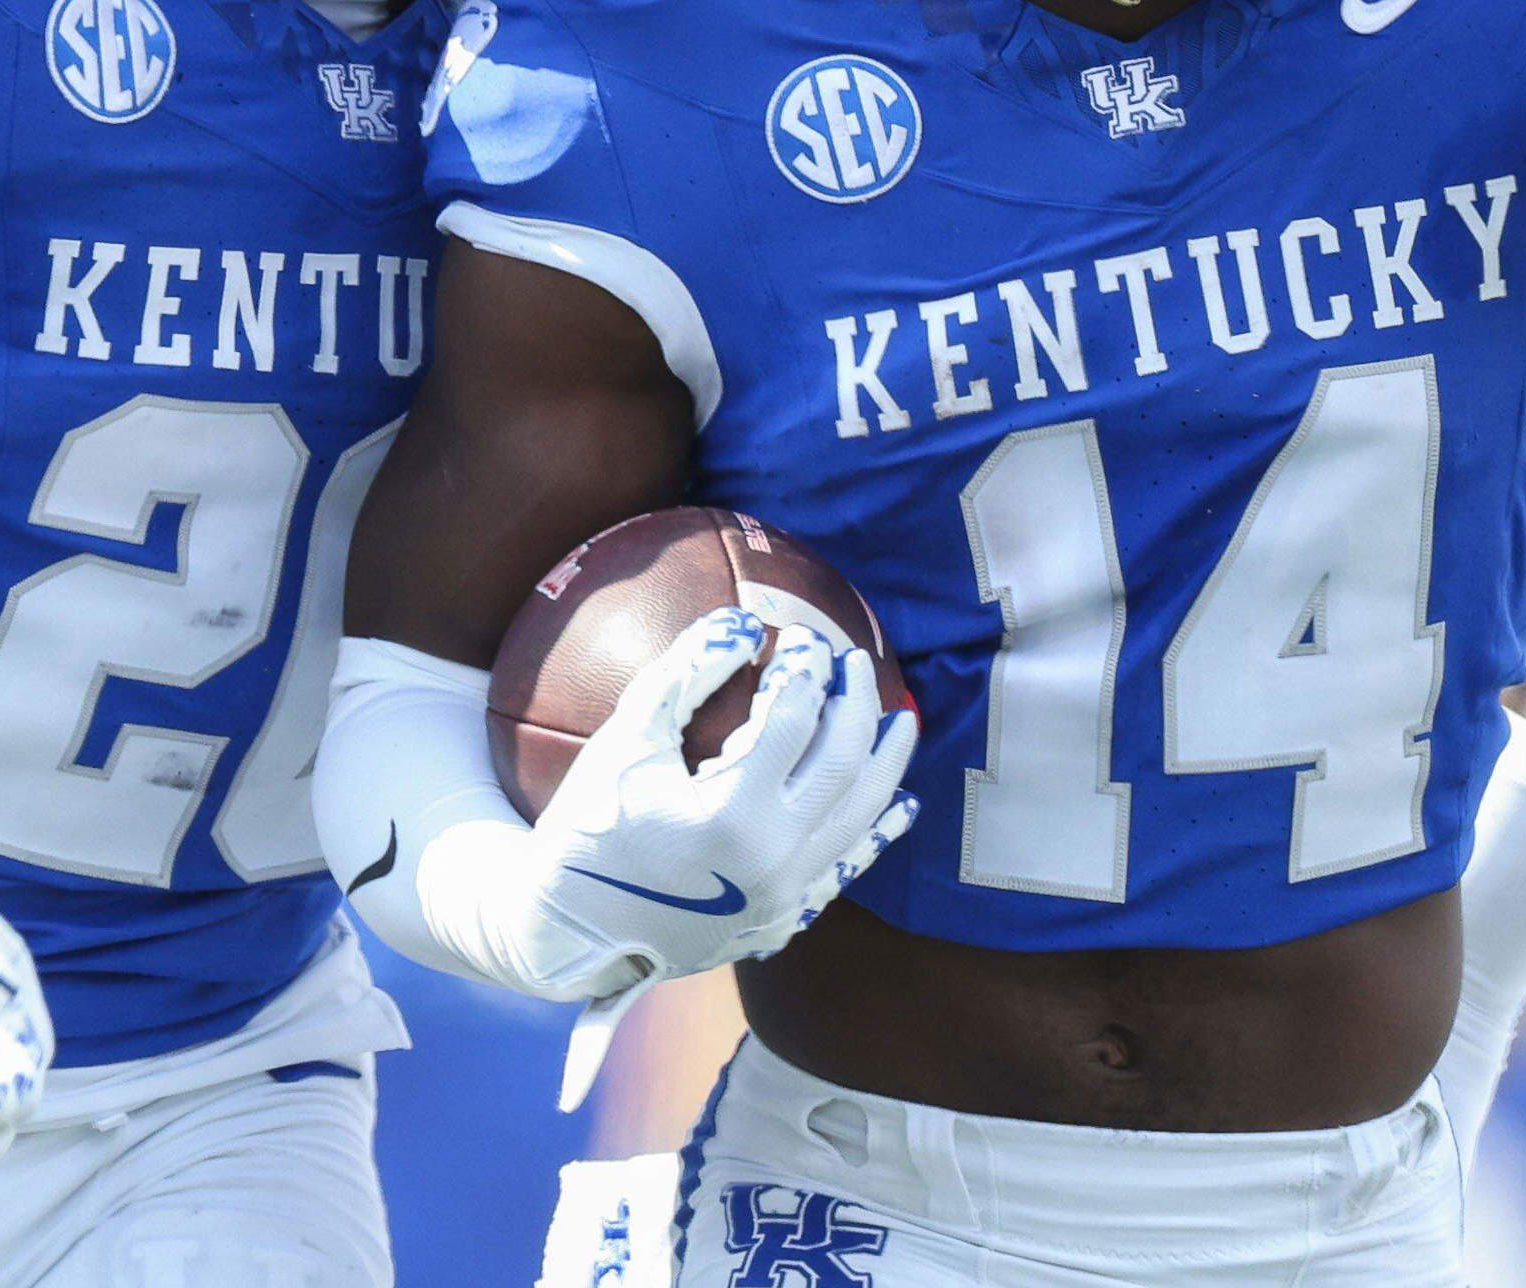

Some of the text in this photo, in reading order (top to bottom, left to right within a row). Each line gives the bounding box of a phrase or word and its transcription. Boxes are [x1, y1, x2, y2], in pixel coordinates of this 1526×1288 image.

[318, 63, 398, 142] UK
[778, 66, 903, 190] SEC
[1081, 56, 1187, 140] UK
[824, 175, 1518, 439] KENTUCKY
[959, 354, 1446, 904] 14
[719, 1180, 888, 1288] UK
